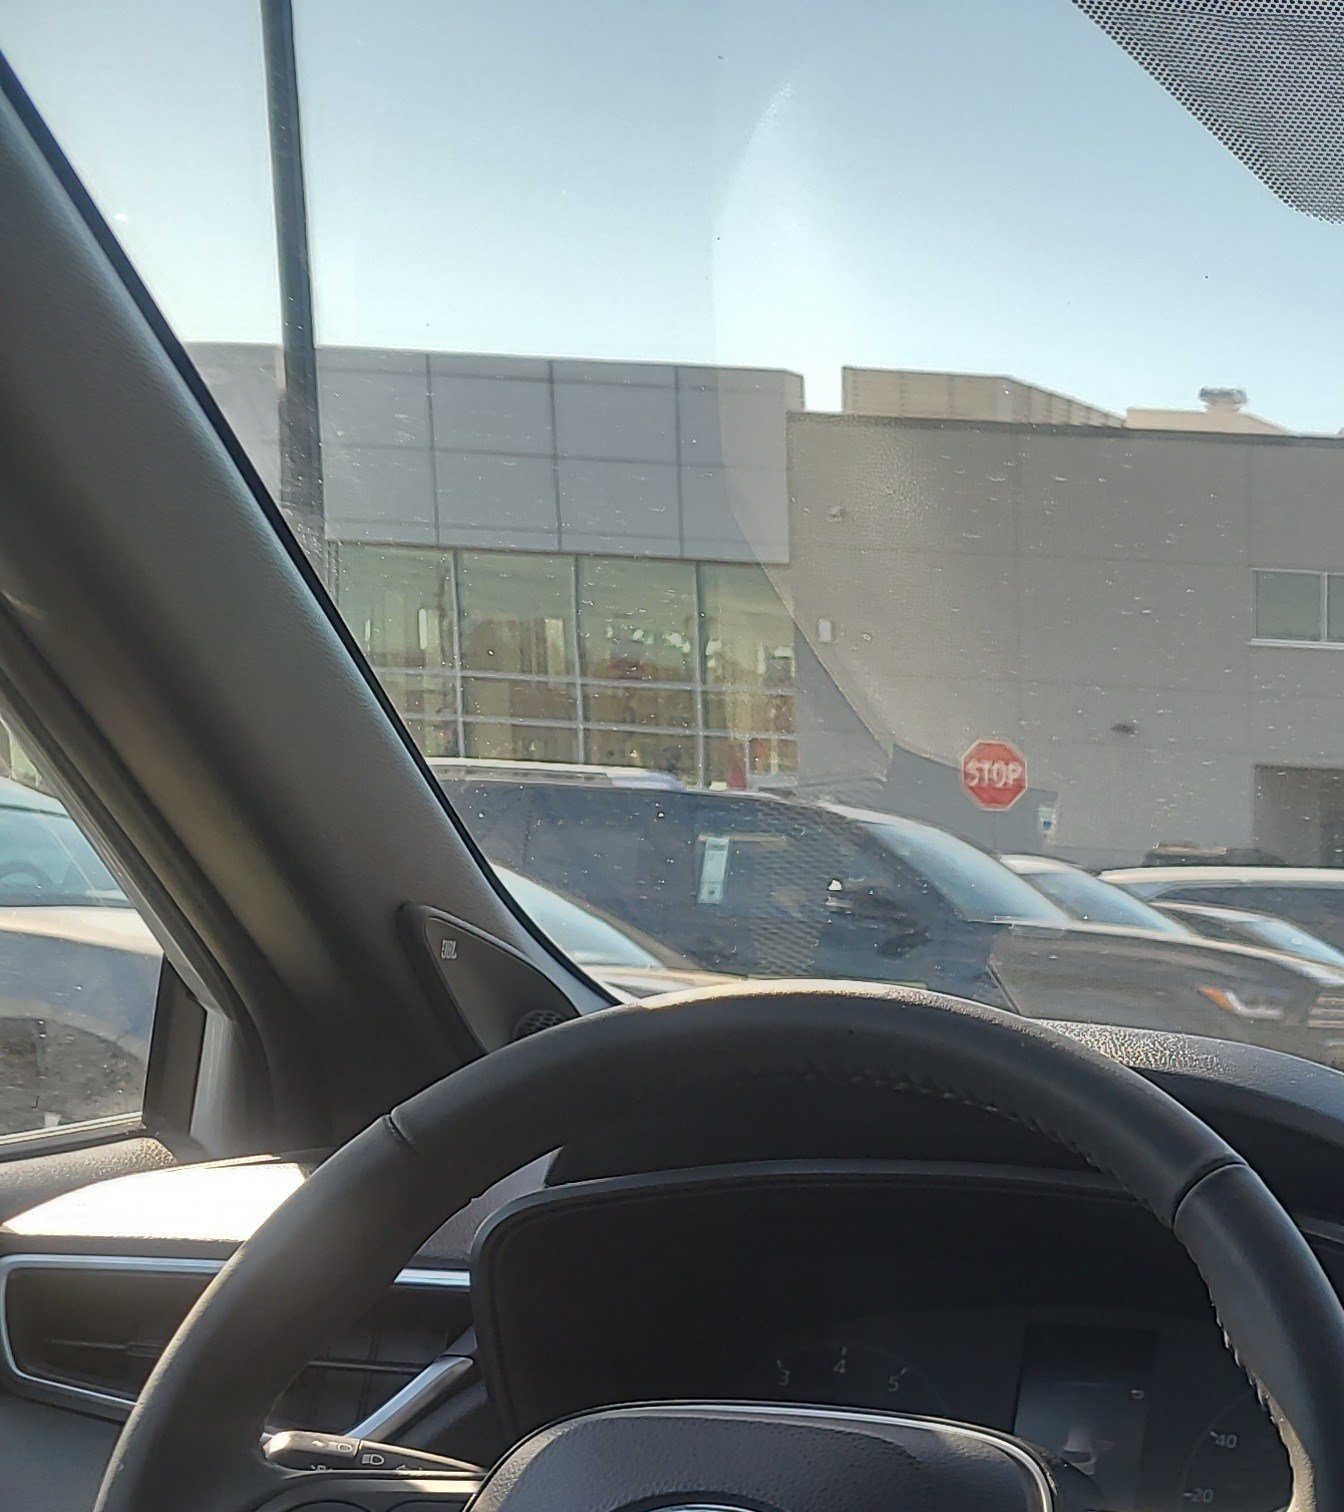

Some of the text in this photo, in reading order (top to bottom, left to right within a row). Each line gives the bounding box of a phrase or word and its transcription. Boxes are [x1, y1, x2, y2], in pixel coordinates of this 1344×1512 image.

[965, 759, 1022, 788] STOP
[441, 939, 457, 959] JBL
[833, 1359, 847, 1374] 4
[778, 1369, 790, 1386] 3
[888, 1375, 899, 1392] 5
[1214, 1433, 1238, 1449] 40
[1191, 1487, 1214, 1504] 20
